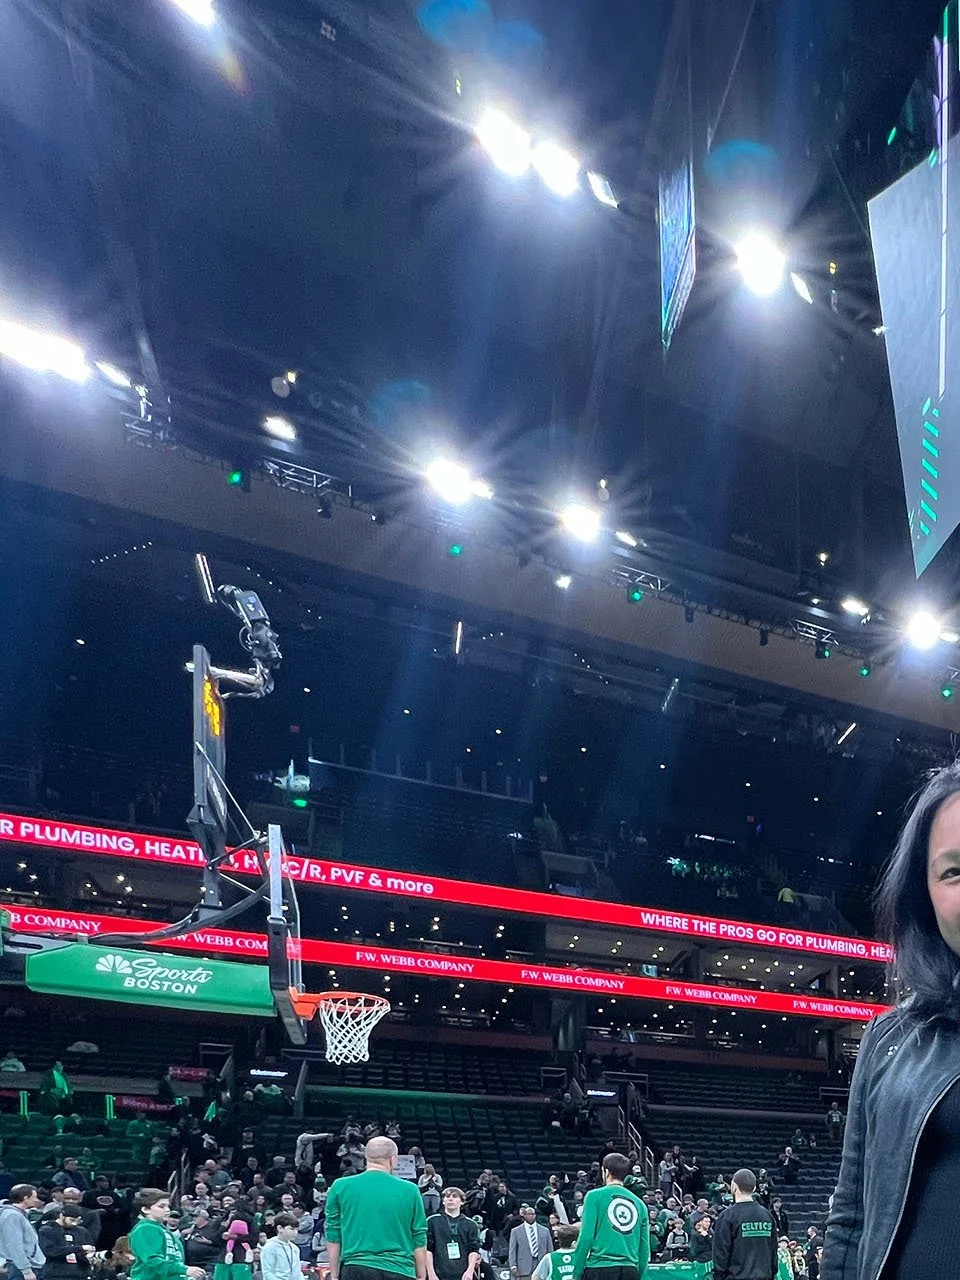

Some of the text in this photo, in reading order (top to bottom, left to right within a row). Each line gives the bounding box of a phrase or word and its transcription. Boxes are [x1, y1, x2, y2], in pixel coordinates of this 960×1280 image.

[20, 821, 140, 855] PLUMBING,
[331, 868, 364, 884] PVF
[369, 874, 383, 888] &
[387, 877, 435, 894] more
[24, 914, 101, 932] COMPANY
[193, 932, 234, 946] WEBB
[641, 912, 689, 930] WHERE
[691, 919, 717, 934] THE
[719, 923, 754, 939] PROS
[756, 929, 776, 942] GO
[779, 933, 803, 946] FOR
[805, 938, 869, 957] PLUMBING,
[132, 958, 213, 984] Sports
[355, 951, 475, 974] F.W. WEBB COMPANY
[124, 976, 198, 995] BOSTON
[542, 972, 574, 984] WEBB
[574, 976, 625, 990] COMPANY
[684, 988, 711, 999] WEBB
[712, 992, 758, 1004] COMPANY
[810, 1002, 835, 1012] WEBB
[834, 1005, 874, 1016] COMPANY
[741, 1221, 772, 1231] CELTICS
